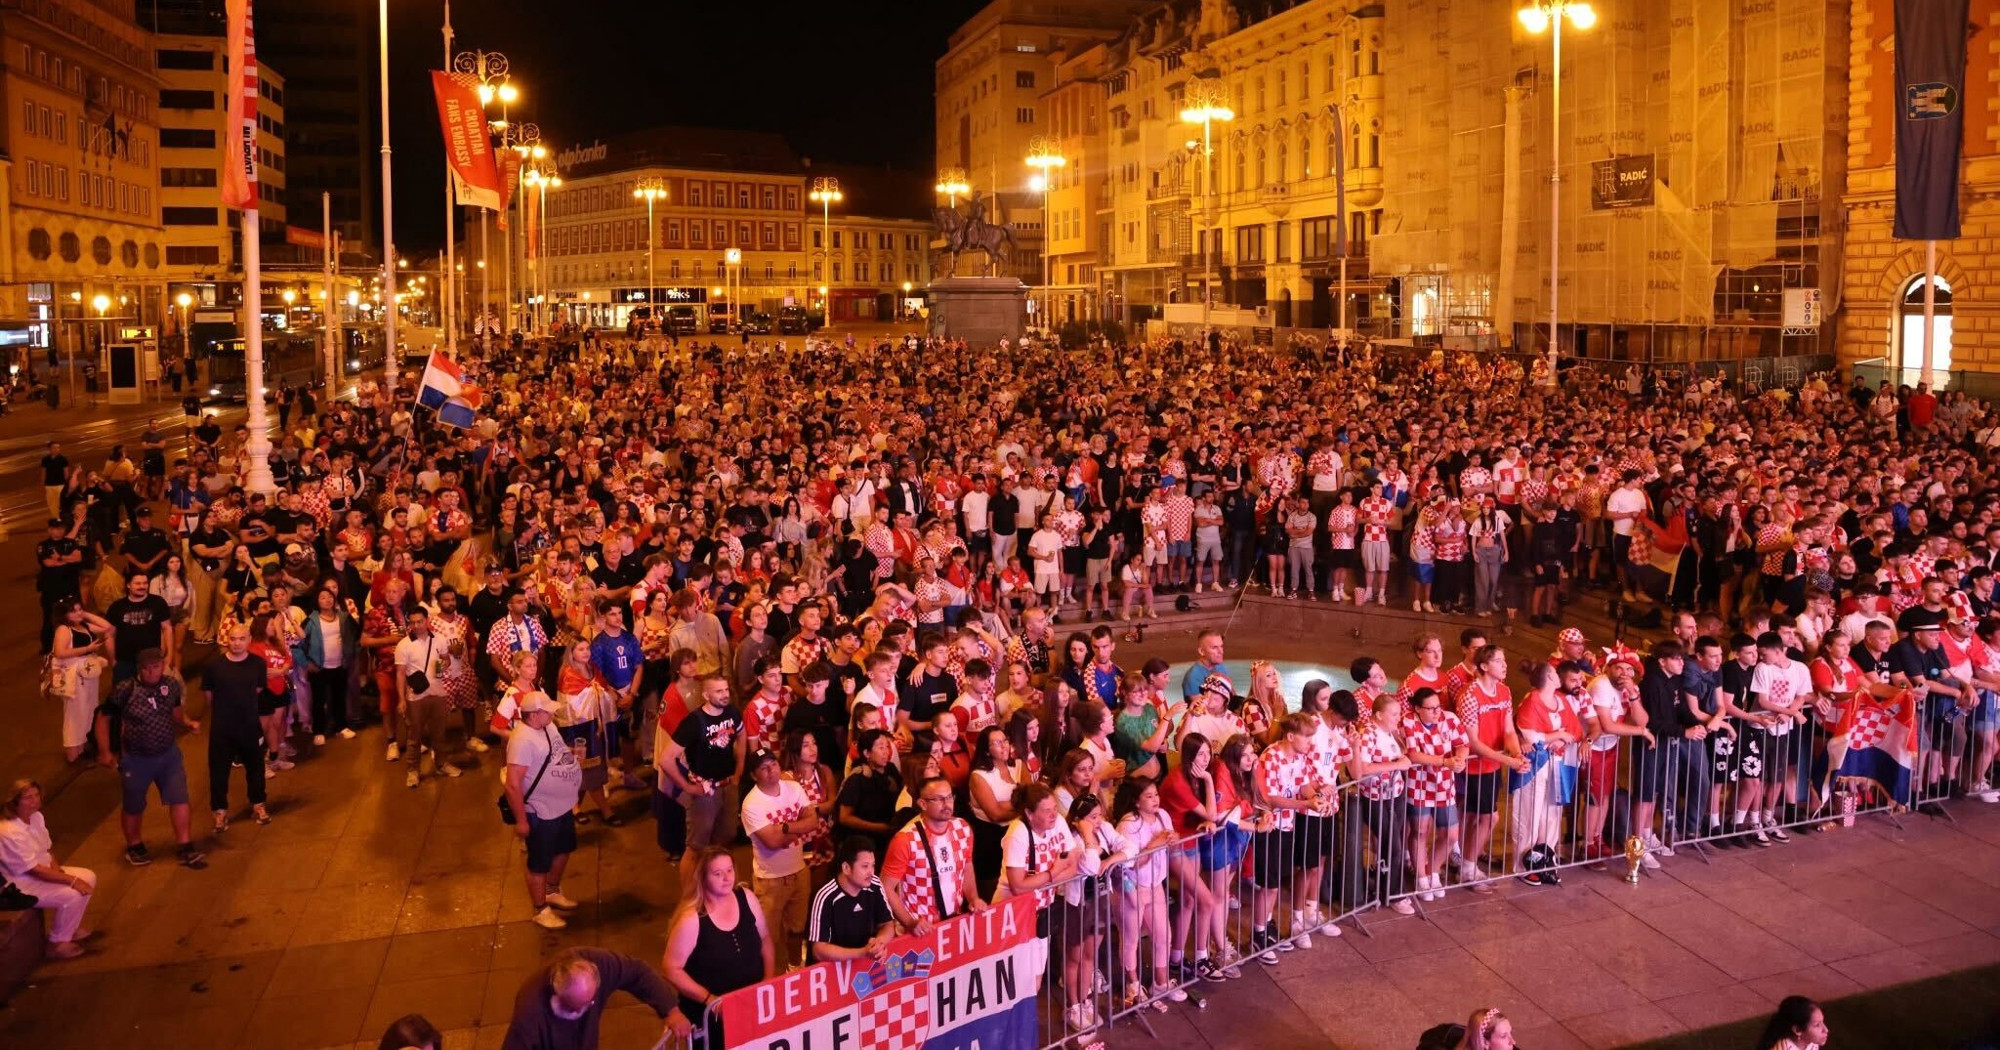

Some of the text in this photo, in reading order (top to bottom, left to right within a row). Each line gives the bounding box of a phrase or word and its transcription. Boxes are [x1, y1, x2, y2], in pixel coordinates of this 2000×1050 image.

[446, 99, 472, 167] FANS EMBASSY
[465, 108, 486, 156] CROATIAN
[1620, 167, 1648, 182] RADIĆ
[618, 655, 628, 669] 10
[939, 865, 953, 873] CRO
